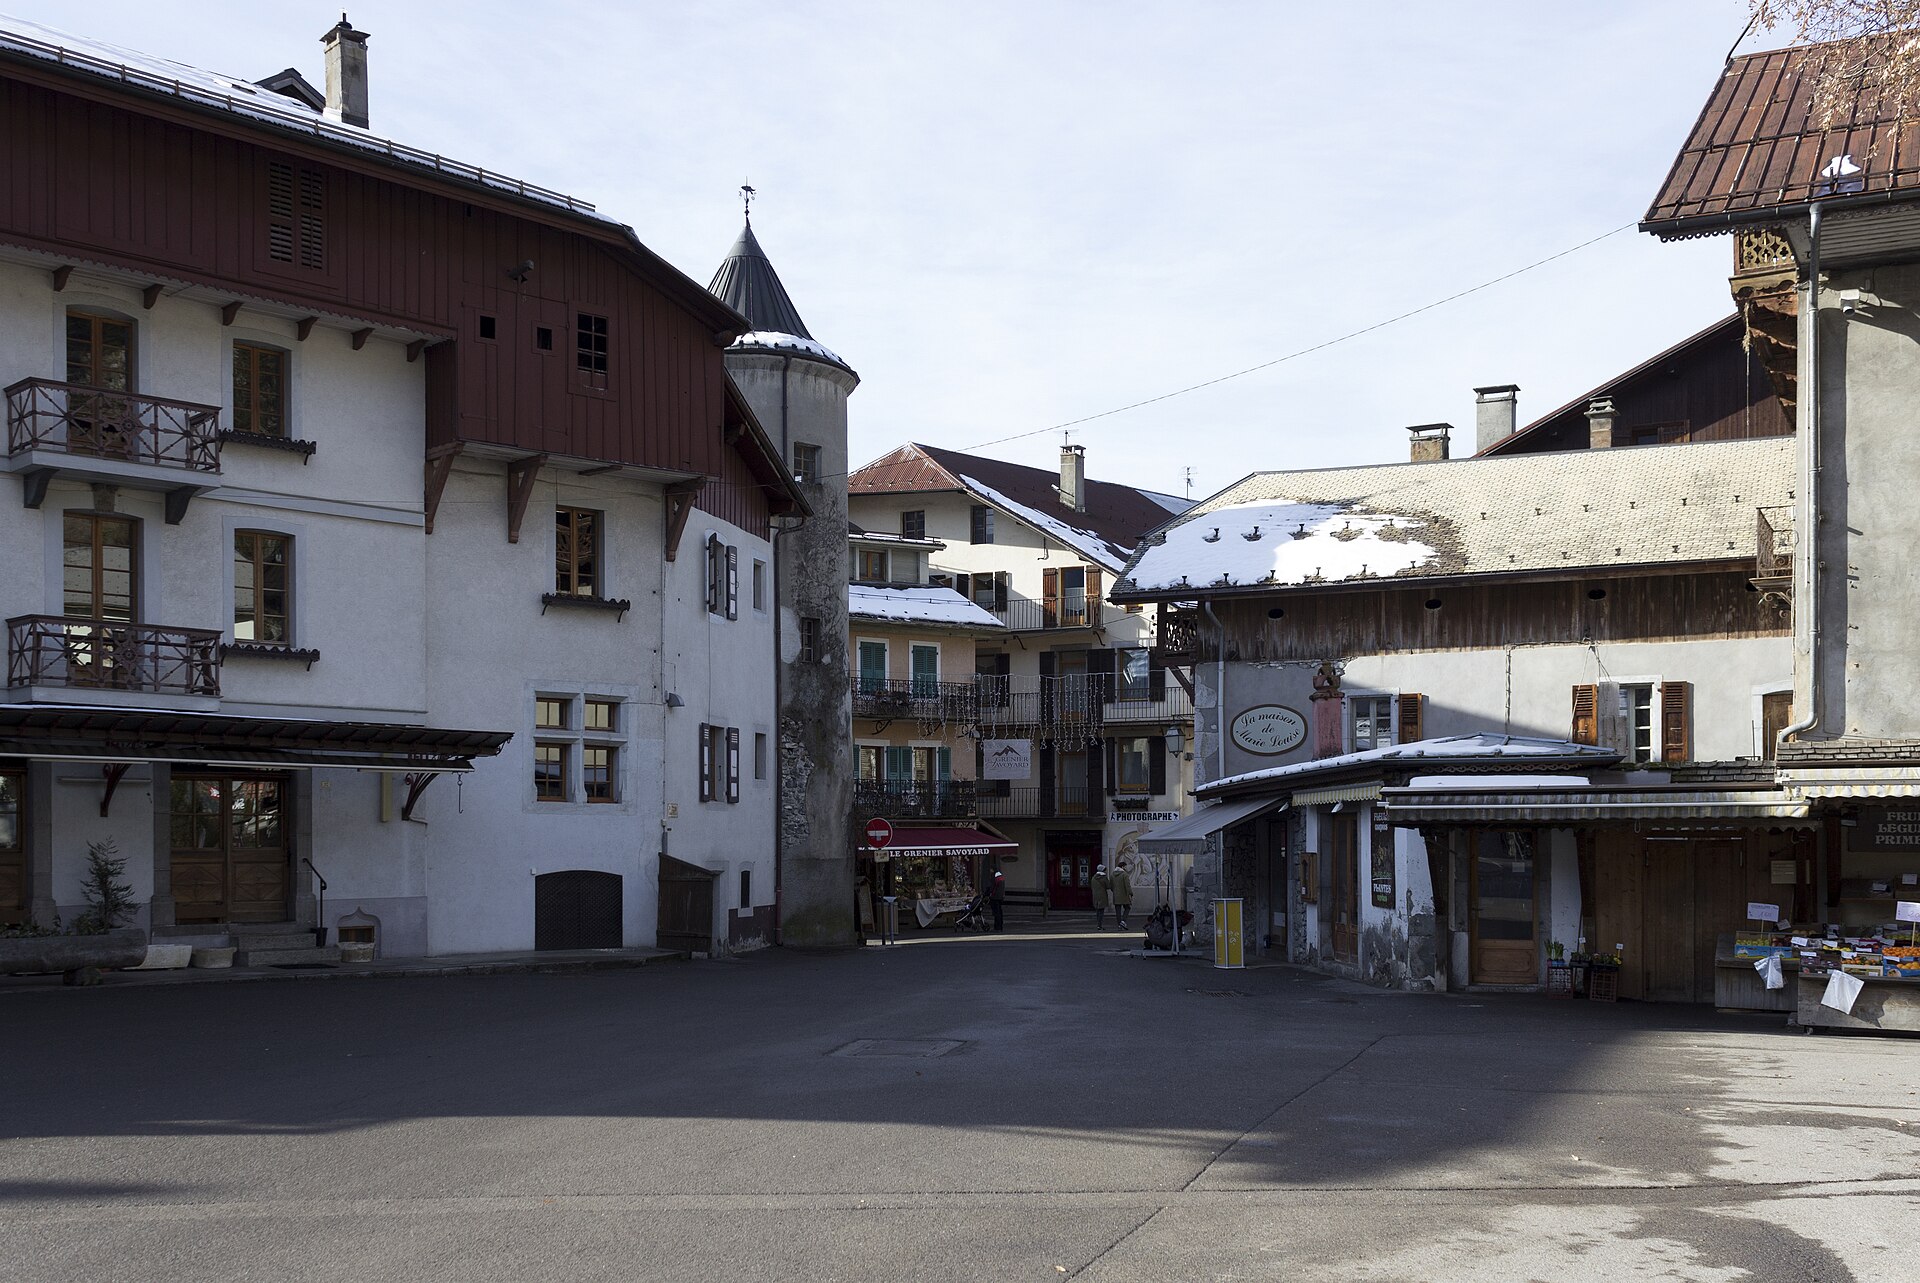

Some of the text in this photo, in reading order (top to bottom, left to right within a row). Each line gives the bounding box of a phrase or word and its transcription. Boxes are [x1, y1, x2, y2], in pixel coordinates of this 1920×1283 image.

[1241, 712, 1296, 729] La maison
[1262, 723, 1274, 733] de
[1236, 729, 1300, 747] Marie Louise
[1116, 812, 1172, 821] PHOTOGRAPHE
[903, 849, 943, 857] GRENIER
[946, 848, 990, 856] SAVOYARD
